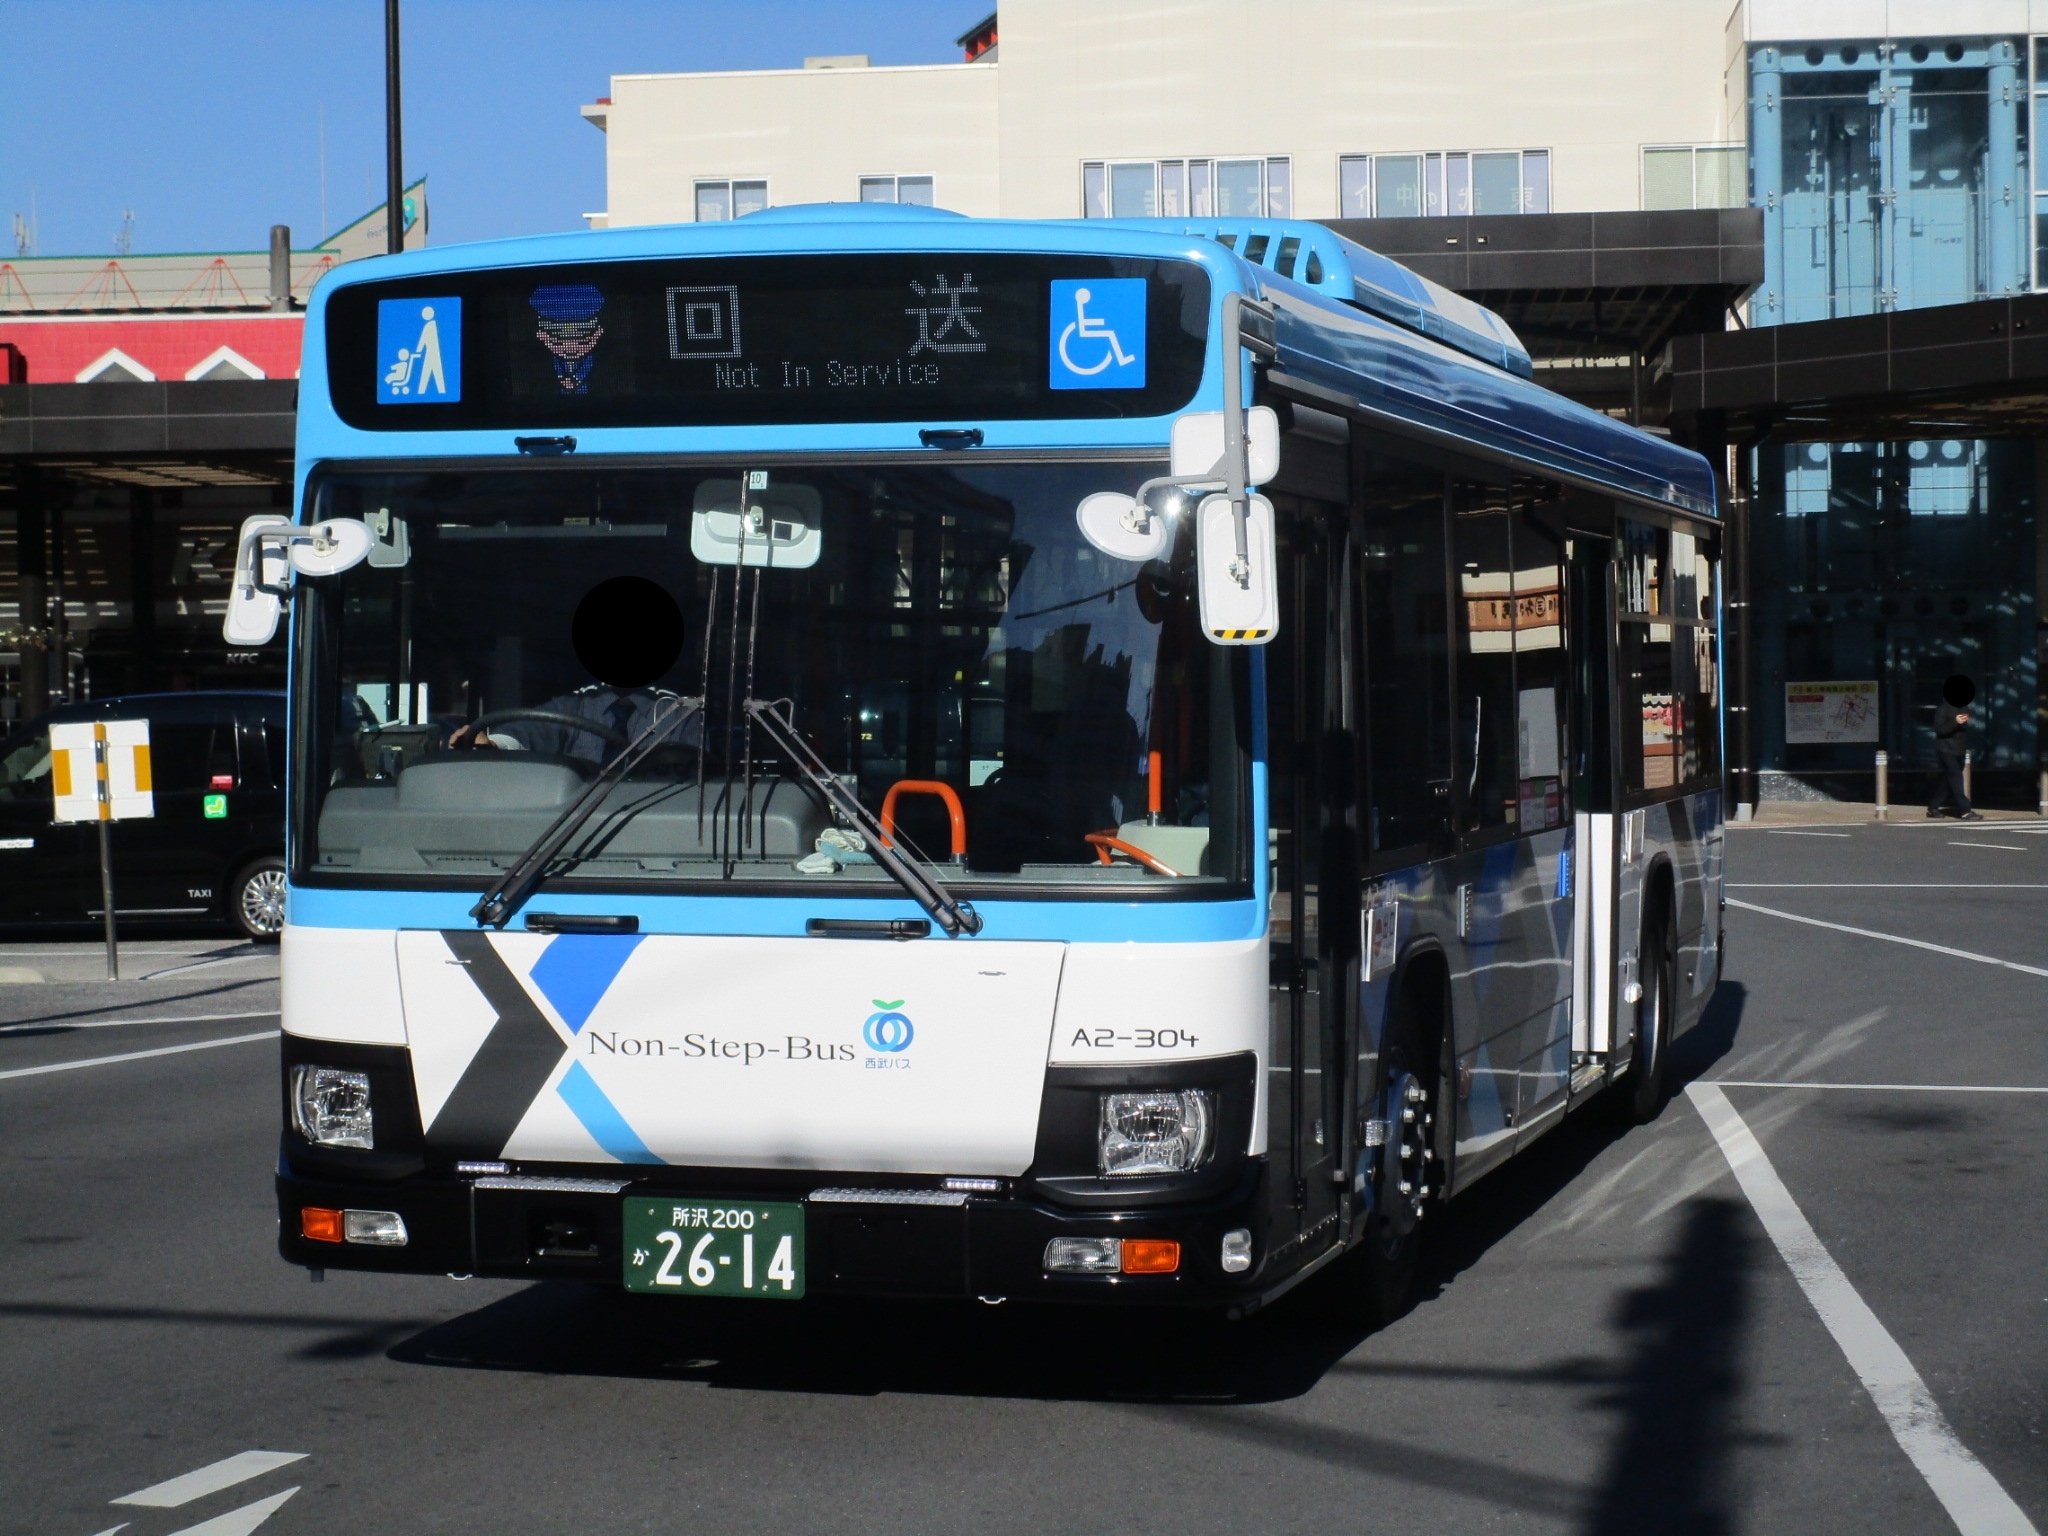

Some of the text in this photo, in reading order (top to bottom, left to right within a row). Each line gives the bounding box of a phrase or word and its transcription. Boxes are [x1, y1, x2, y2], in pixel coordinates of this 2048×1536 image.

[665, 272, 988, 361] 回送
[716, 358, 941, 389] Not In Service
[751, 473, 762, 484] 10
[226, 652, 260, 665] KFC
[188, 888, 212, 898] TAXI
[588, 1031, 856, 1067] Non-Step-Bus
[1071, 1027, 1200, 1049] A2-304
[865, 1057, 912, 1069] 西武バス
[632, 1230, 797, 1291] か 26-14
